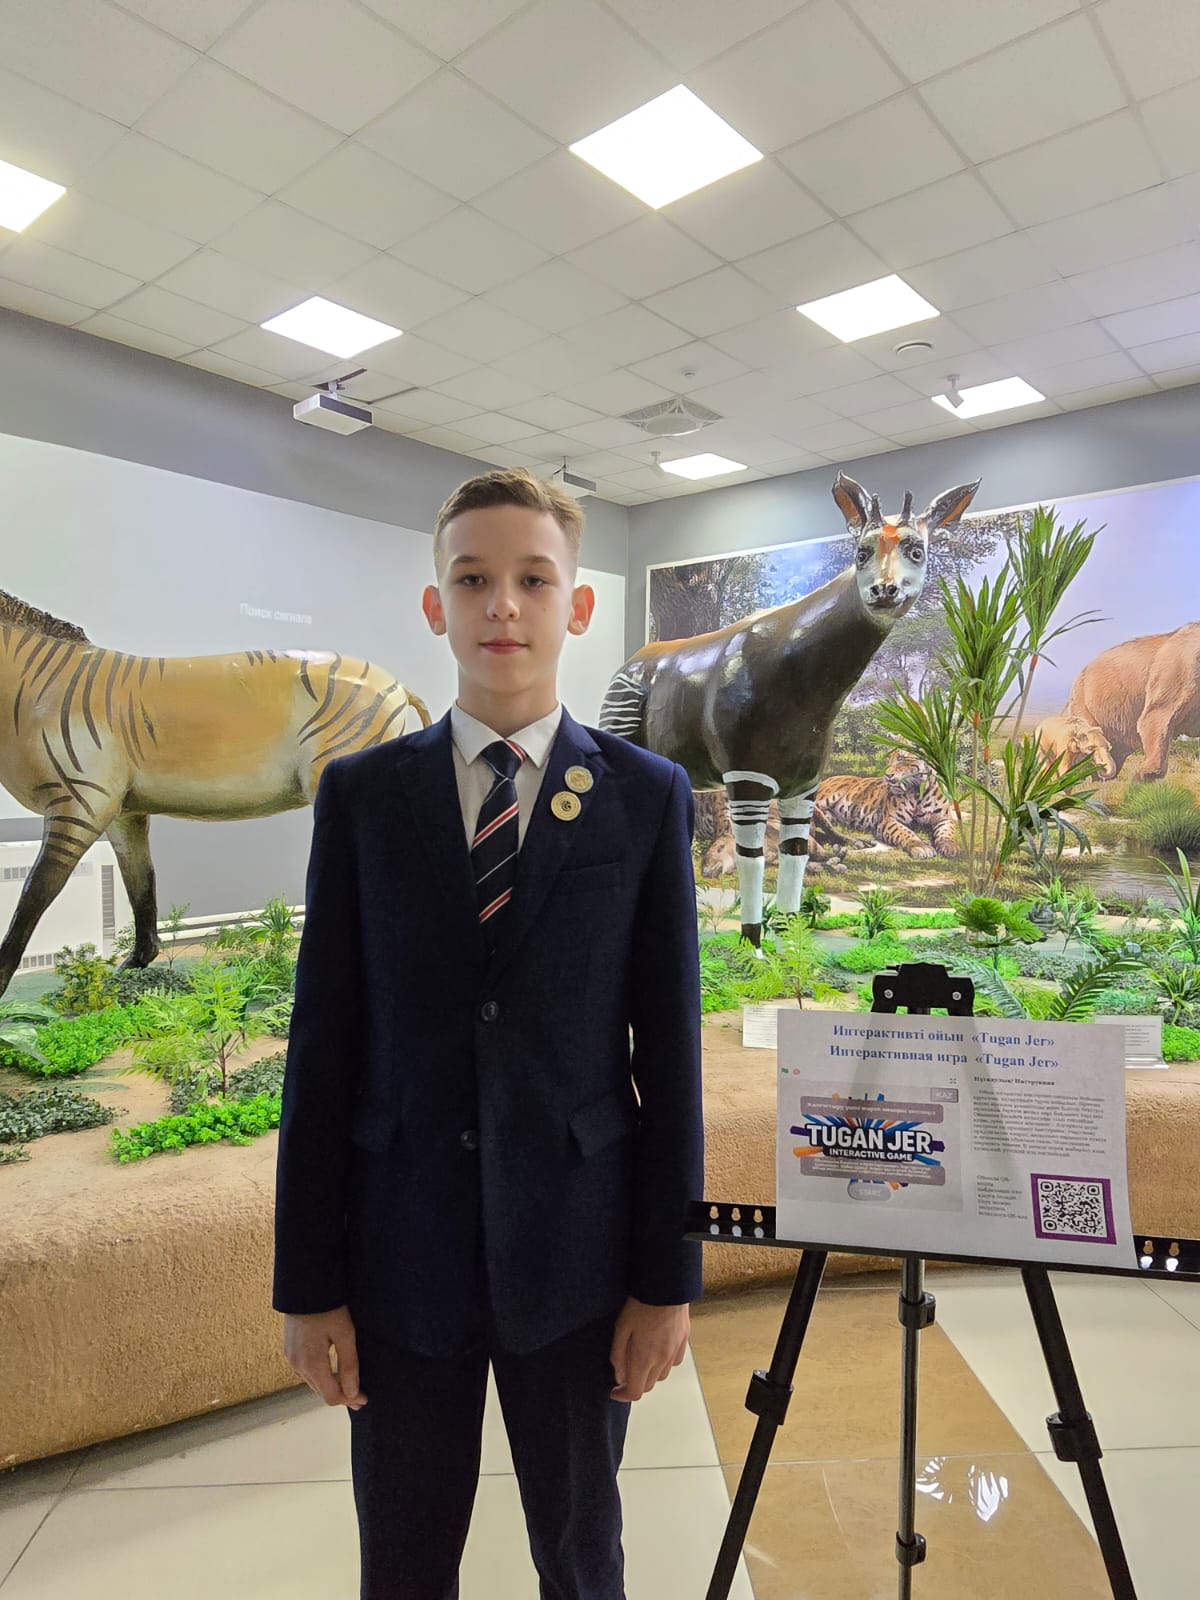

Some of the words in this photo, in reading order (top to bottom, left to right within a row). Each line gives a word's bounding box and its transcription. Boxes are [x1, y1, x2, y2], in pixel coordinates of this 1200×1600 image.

[240, 602, 272, 619] Поиск
[832, 1024, 925, 1041] Интерактивті
[928, 1029, 964, 1043] ойын
[971, 1031, 1021, 1048] «Tugan
[1025, 1035, 1055, 1048] Jer»
[829, 1045, 933, 1062] Интерактивная
[937, 1054, 968, 1065] игра
[975, 1053, 1025, 1070] «Tugan
[1028, 1056, 1059, 1069] Jer»
[806, 1124, 884, 1150] TUGAN
[887, 1130, 932, 1154] JER
[829, 1147, 886, 1160] INTERACTIVE
[886, 1151, 913, 1161] GAME
